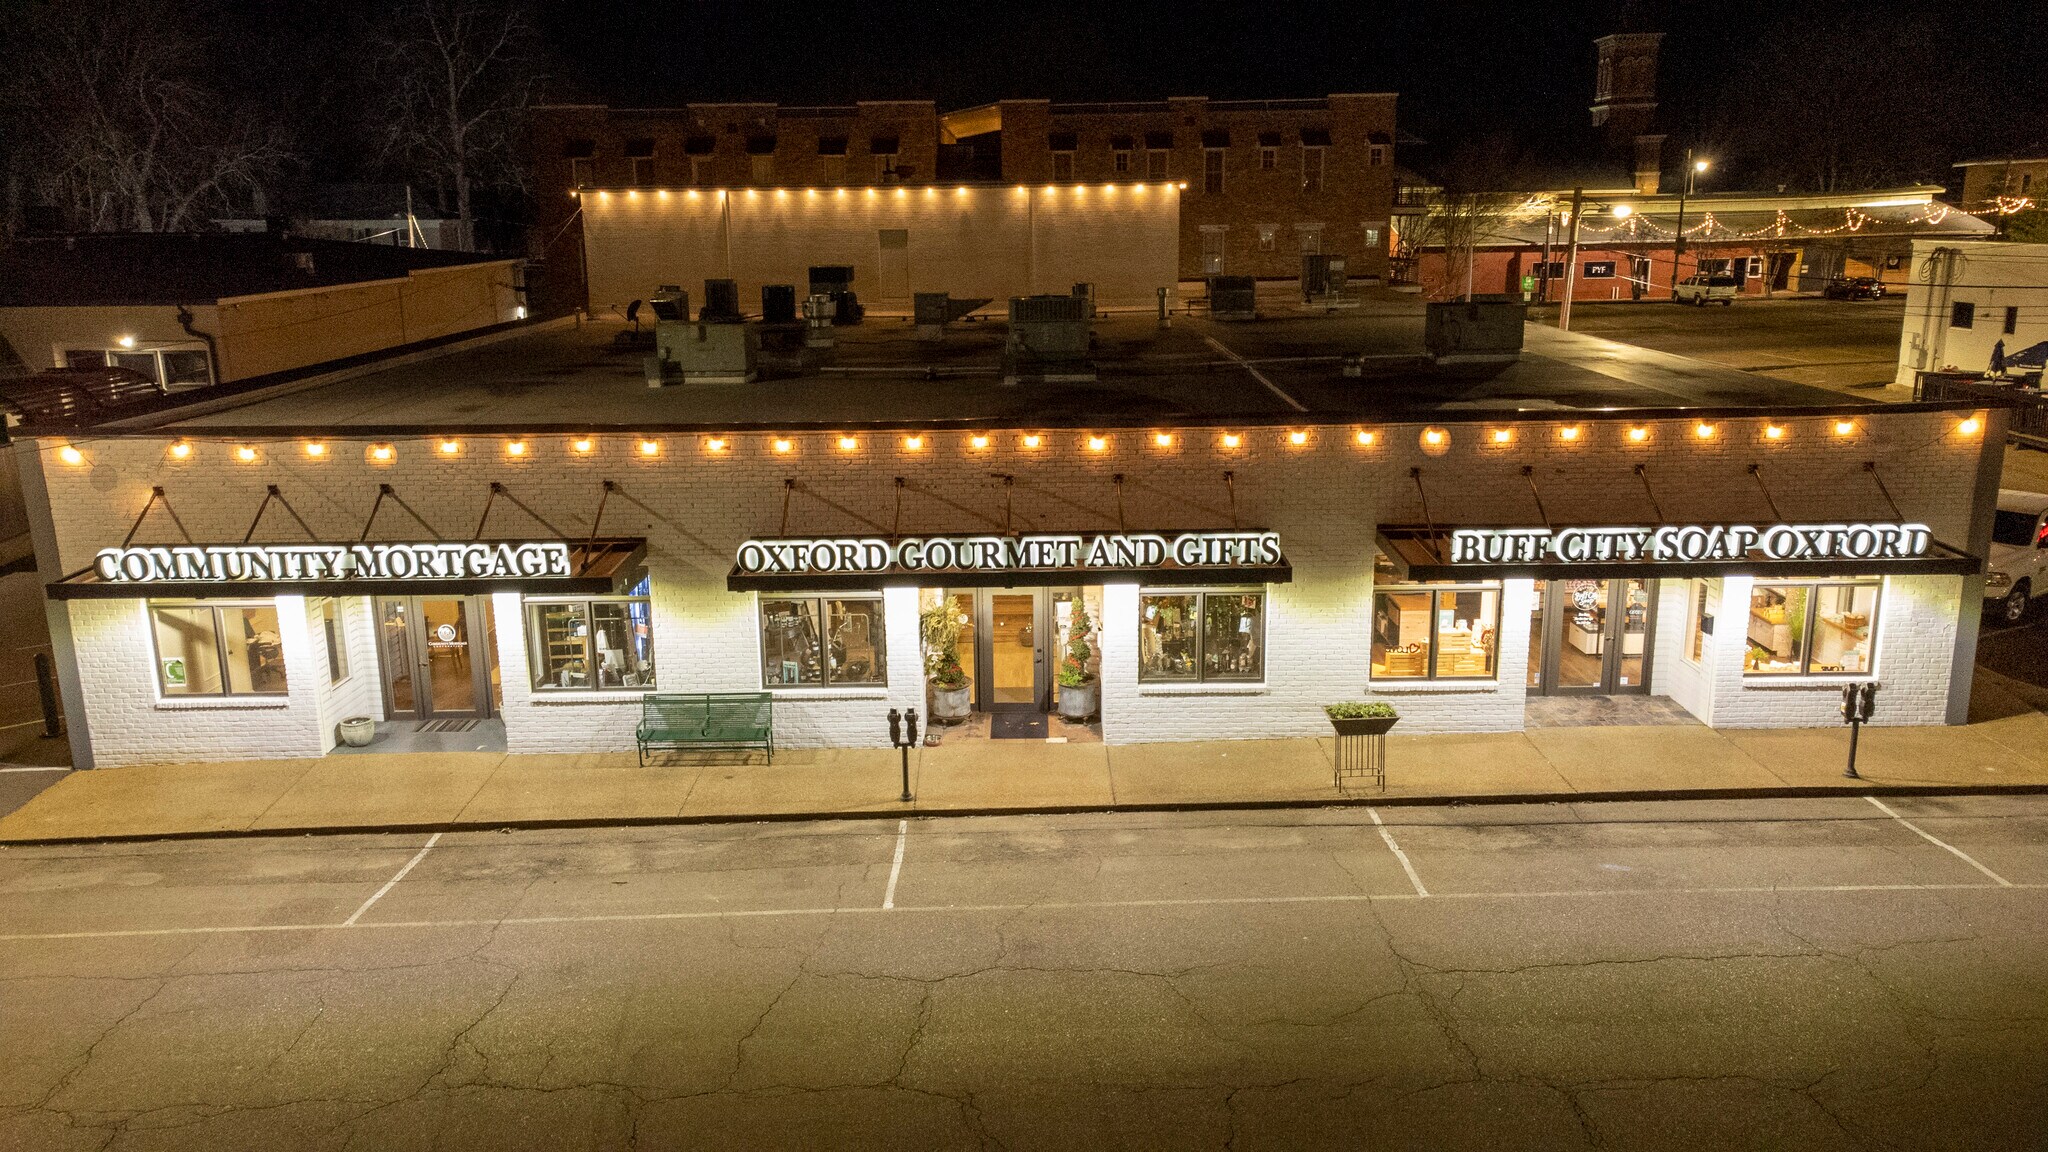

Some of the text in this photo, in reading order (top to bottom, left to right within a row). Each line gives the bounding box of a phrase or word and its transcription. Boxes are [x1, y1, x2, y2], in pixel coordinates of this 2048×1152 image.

[738, 534, 1281, 573] OXFORD GOURMET AND GIFTS
[1454, 526, 1932, 563] BUFF CITY SOAP OXFORD
[93, 546, 568, 582] COMMUNITY MORTGAGE
